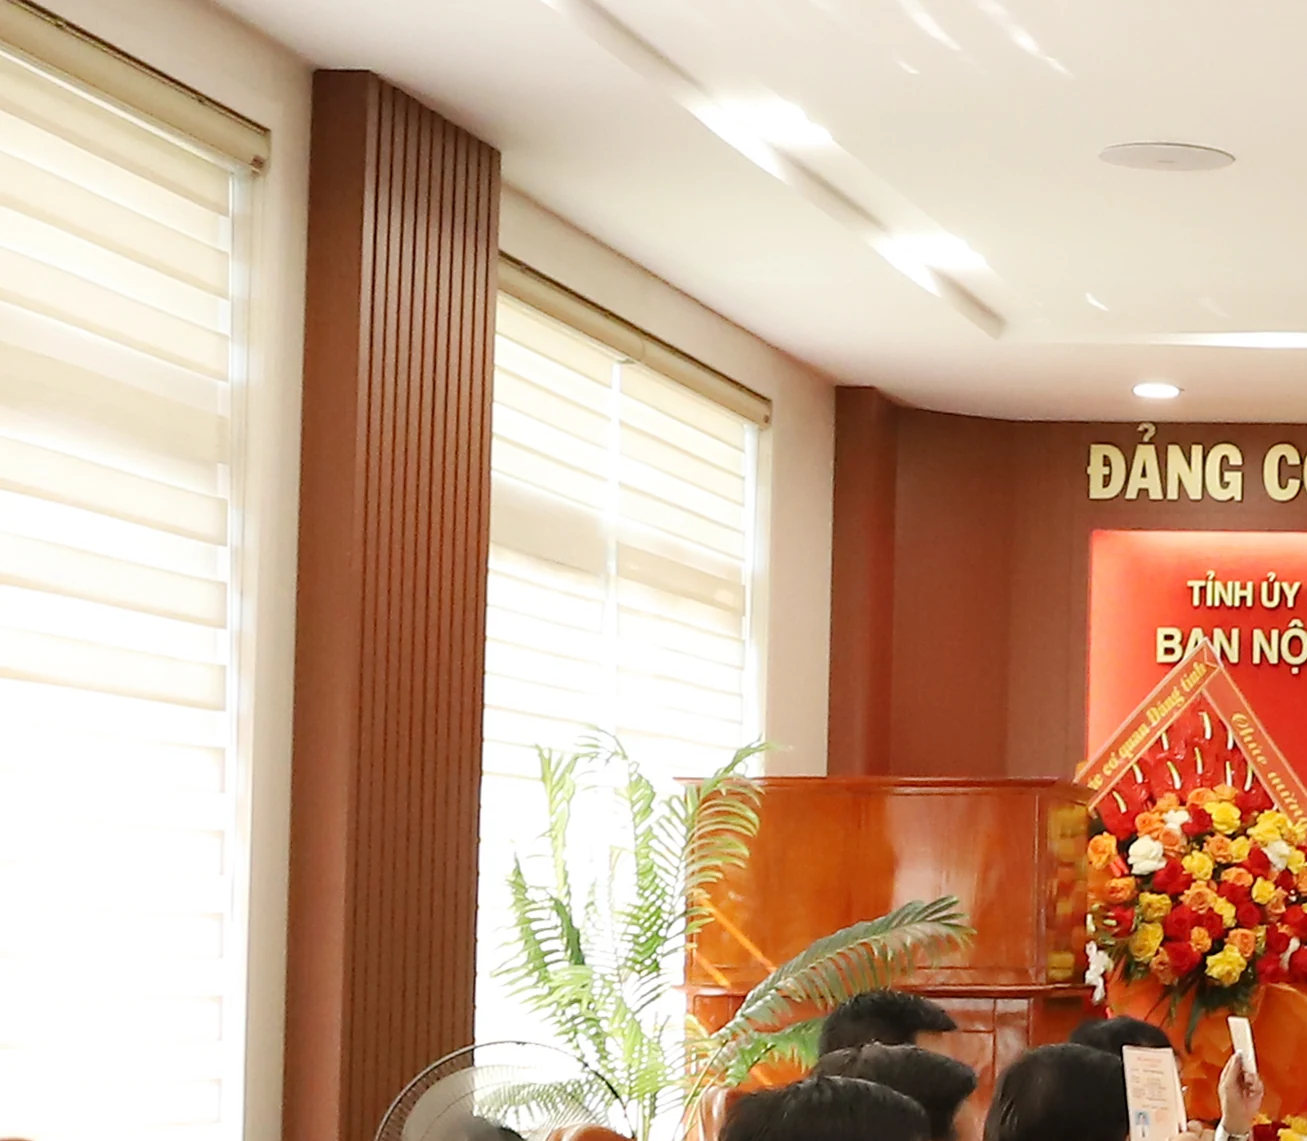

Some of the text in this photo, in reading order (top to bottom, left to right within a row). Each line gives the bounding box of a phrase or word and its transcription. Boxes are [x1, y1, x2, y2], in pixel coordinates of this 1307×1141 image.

[1087, 423, 1243, 501] ĐẢNG
[1187, 570, 1253, 607] TỈNH
[1260, 571, 1301, 608] ỦY
[1156, 627, 1240, 664] BAN
